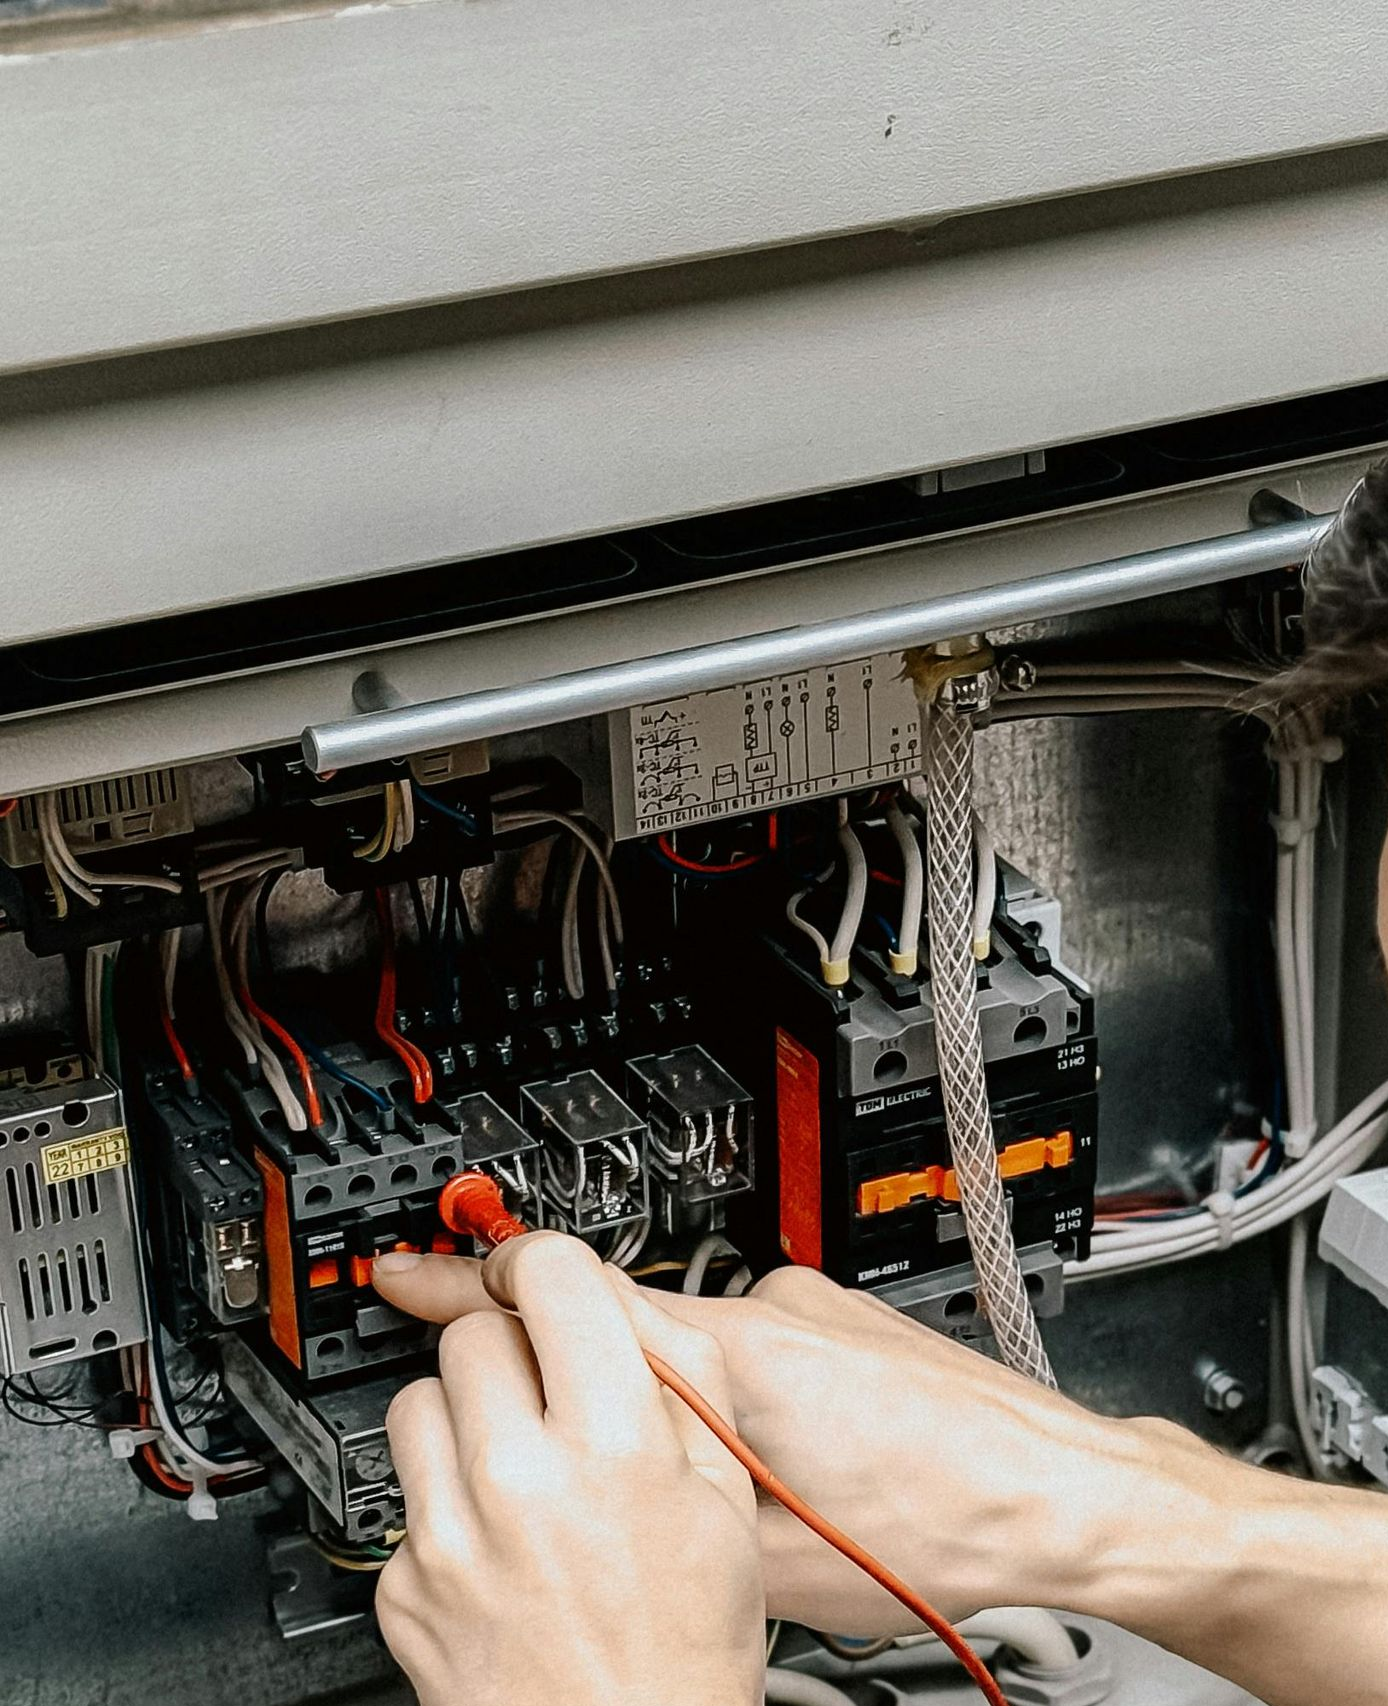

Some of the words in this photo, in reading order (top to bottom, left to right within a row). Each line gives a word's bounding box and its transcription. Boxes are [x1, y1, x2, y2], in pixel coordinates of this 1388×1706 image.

[893, 763, 900, 773] 2
[786, 787, 793, 797] 6
[804, 782, 811, 793] 5
[767, 790, 775, 801] 7
[113, 1141, 120, 1149] 3
[52, 1162, 69, 1178] 22
